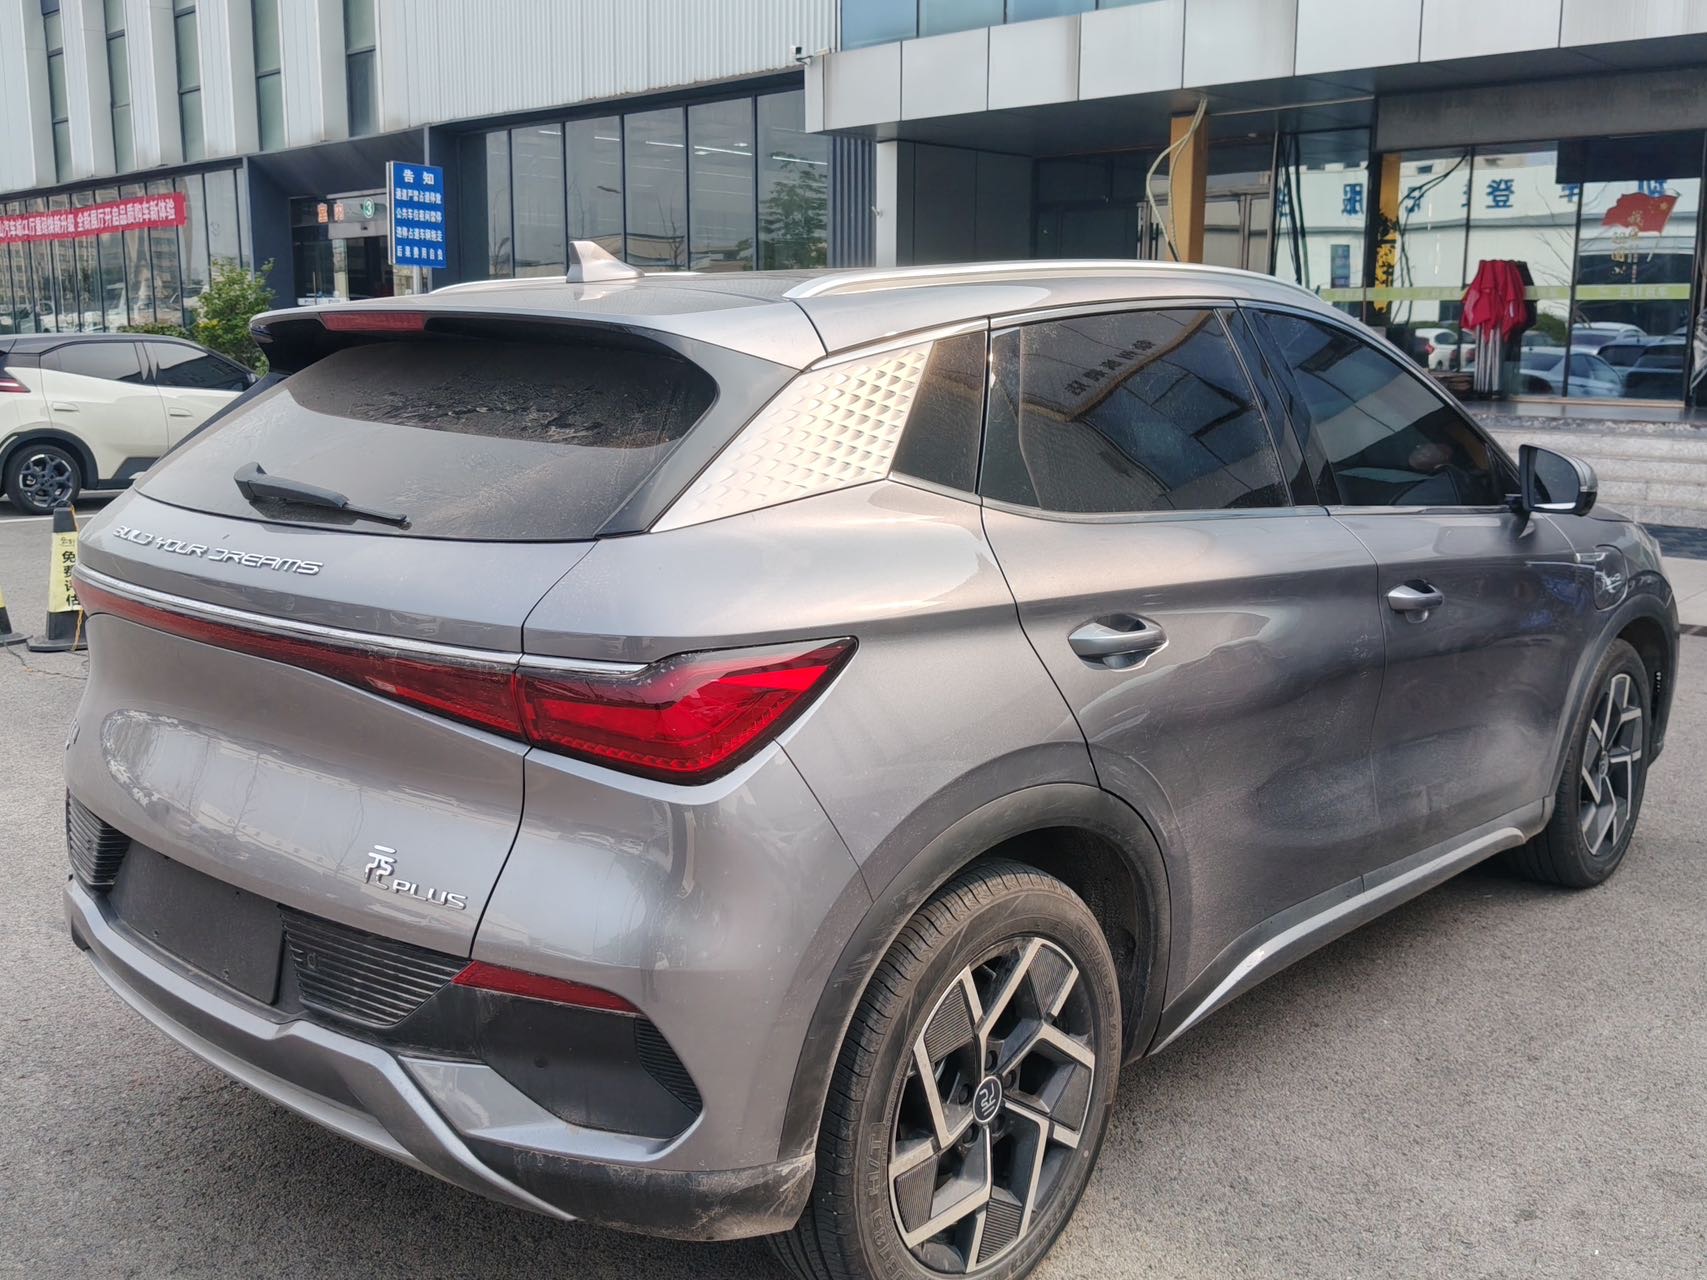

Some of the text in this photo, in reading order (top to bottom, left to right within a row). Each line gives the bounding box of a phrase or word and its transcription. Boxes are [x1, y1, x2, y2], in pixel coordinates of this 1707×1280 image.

[403, 169, 435, 185] 告知
[112, 526, 324, 576] BUILD YOUR DREAMS
[392, 879, 468, 910] PLUS
